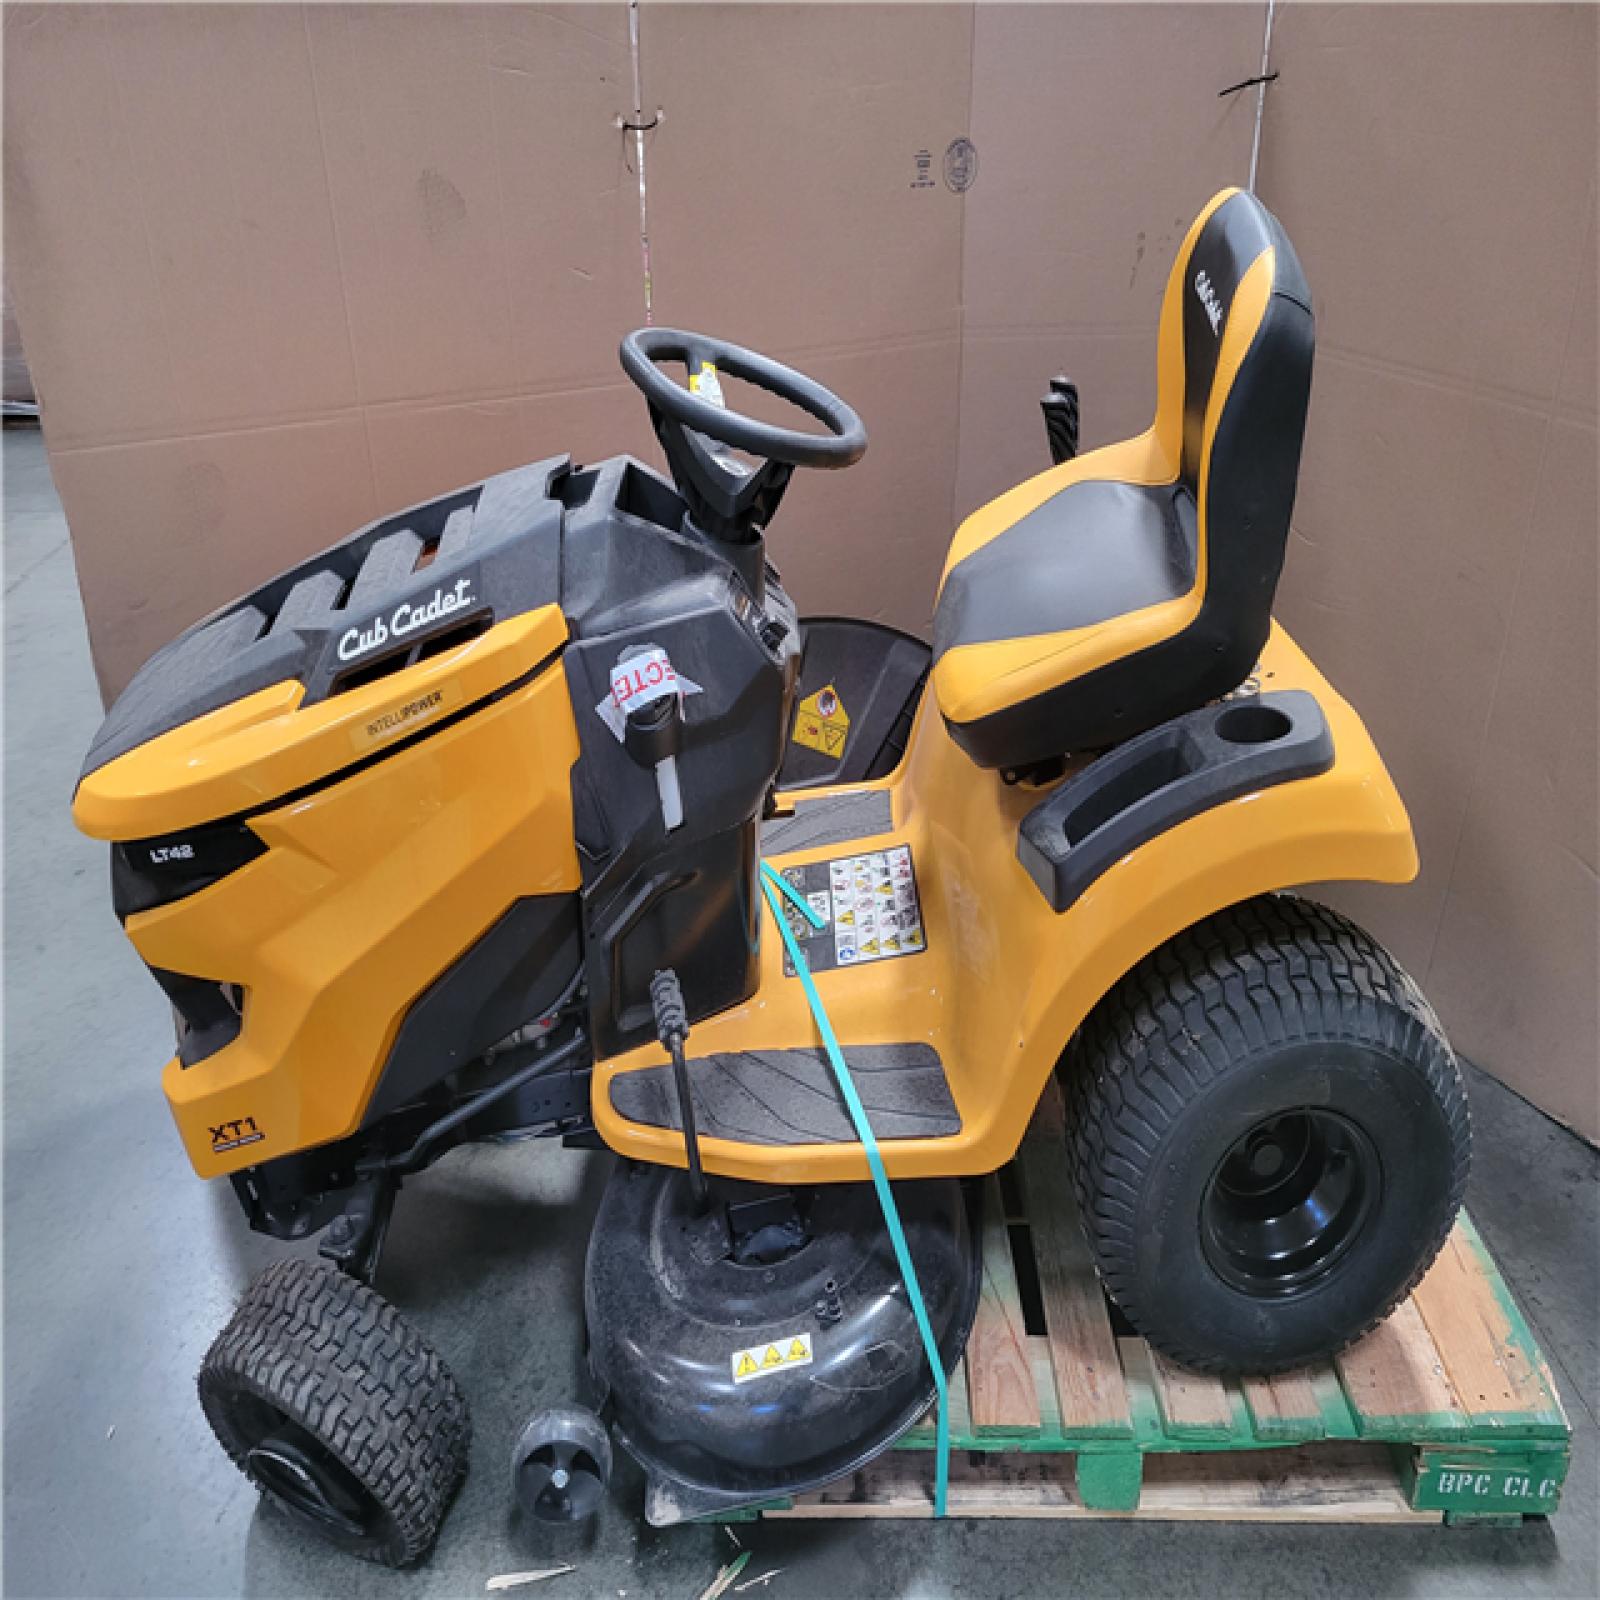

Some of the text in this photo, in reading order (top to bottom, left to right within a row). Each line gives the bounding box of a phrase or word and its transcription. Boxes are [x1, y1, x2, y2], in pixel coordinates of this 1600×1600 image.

[338, 578, 473, 661] Cub Cadet
[149, 844, 195, 864] LT42
[207, 1116, 258, 1143] XT1
[1438, 1471, 1556, 1499] BPC CLC
